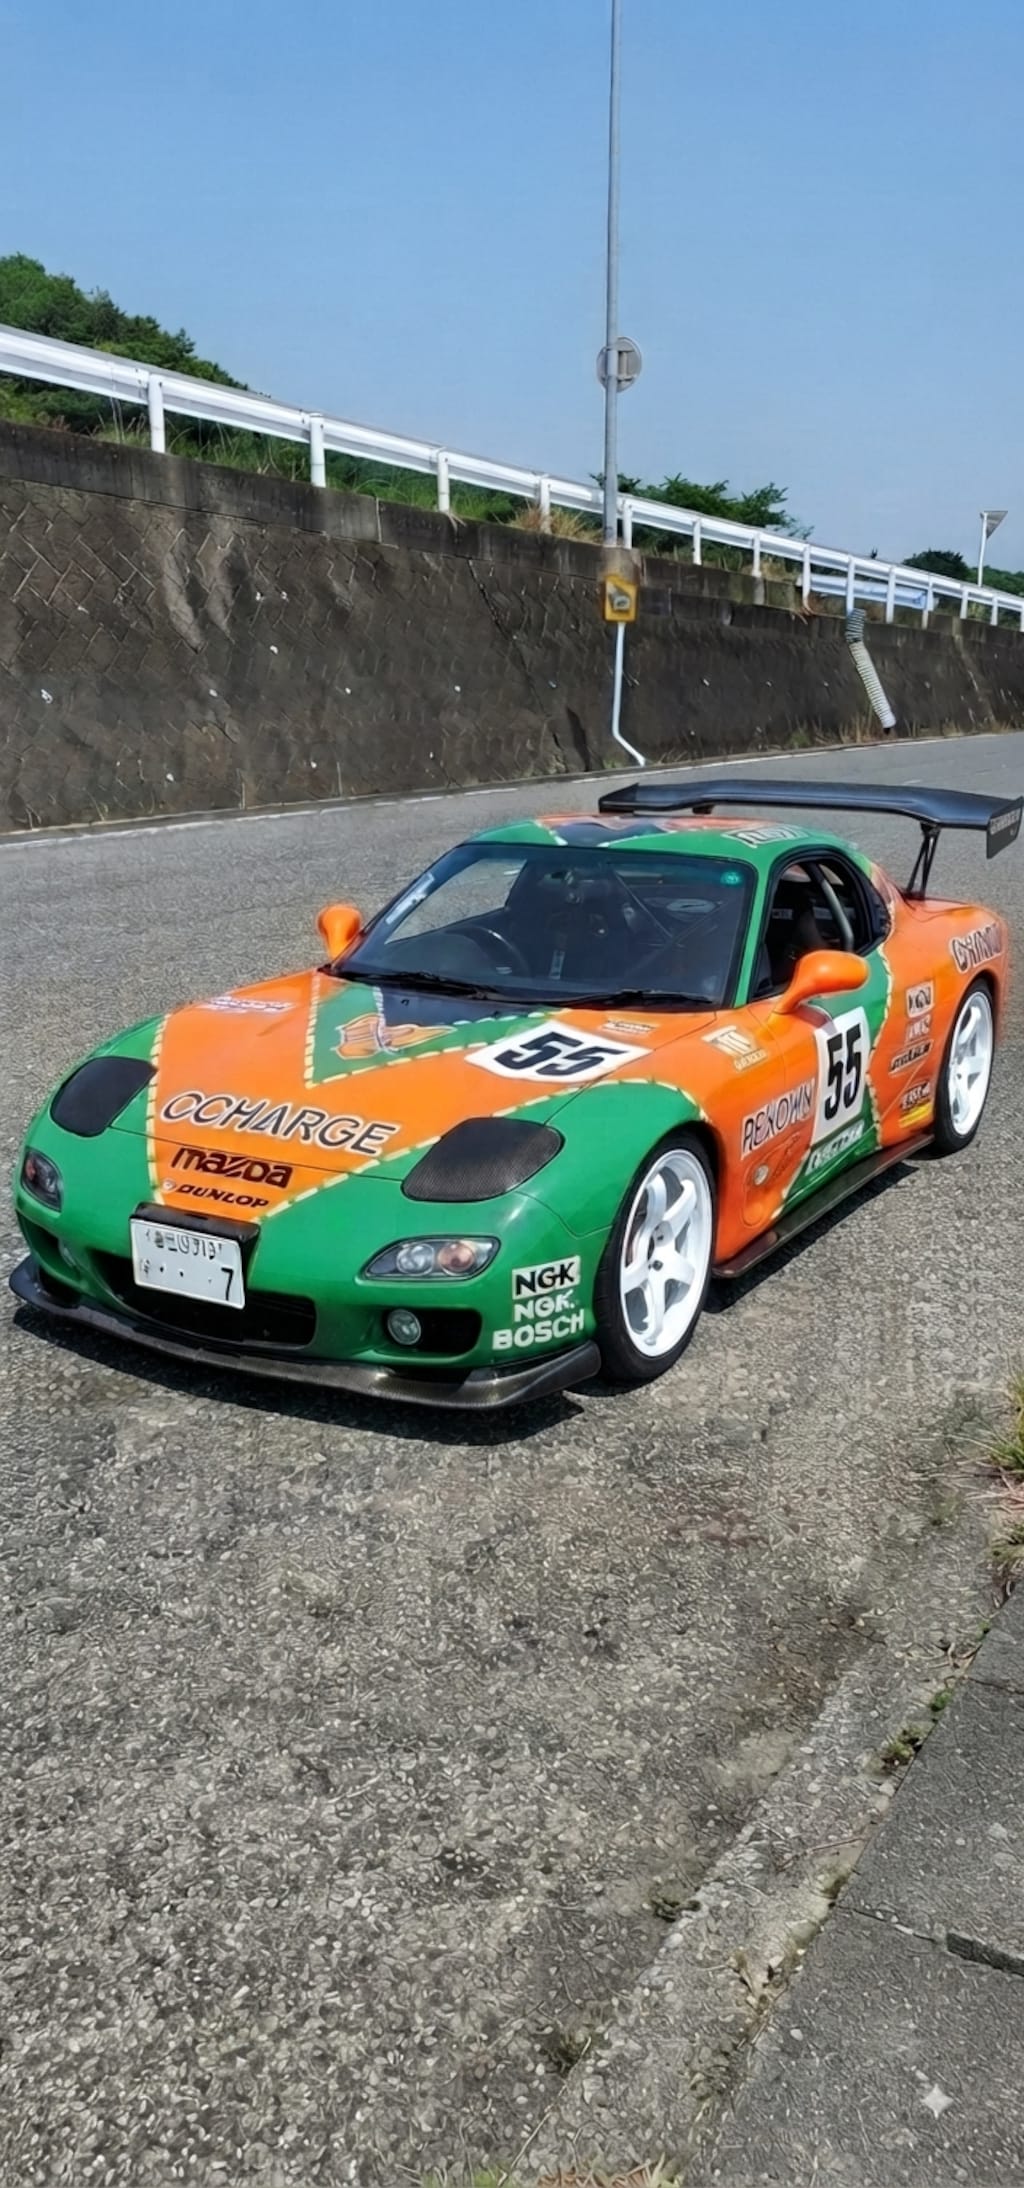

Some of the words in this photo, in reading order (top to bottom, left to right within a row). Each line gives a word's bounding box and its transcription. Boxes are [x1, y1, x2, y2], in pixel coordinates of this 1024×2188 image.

[494, 1032, 628, 1076] 55
[824, 1023, 861, 1121] 55
[176, 1183, 270, 1209] DUNLOP
[515, 1261, 575, 1296] NGK
[492, 1308, 585, 1351] BOSCH
